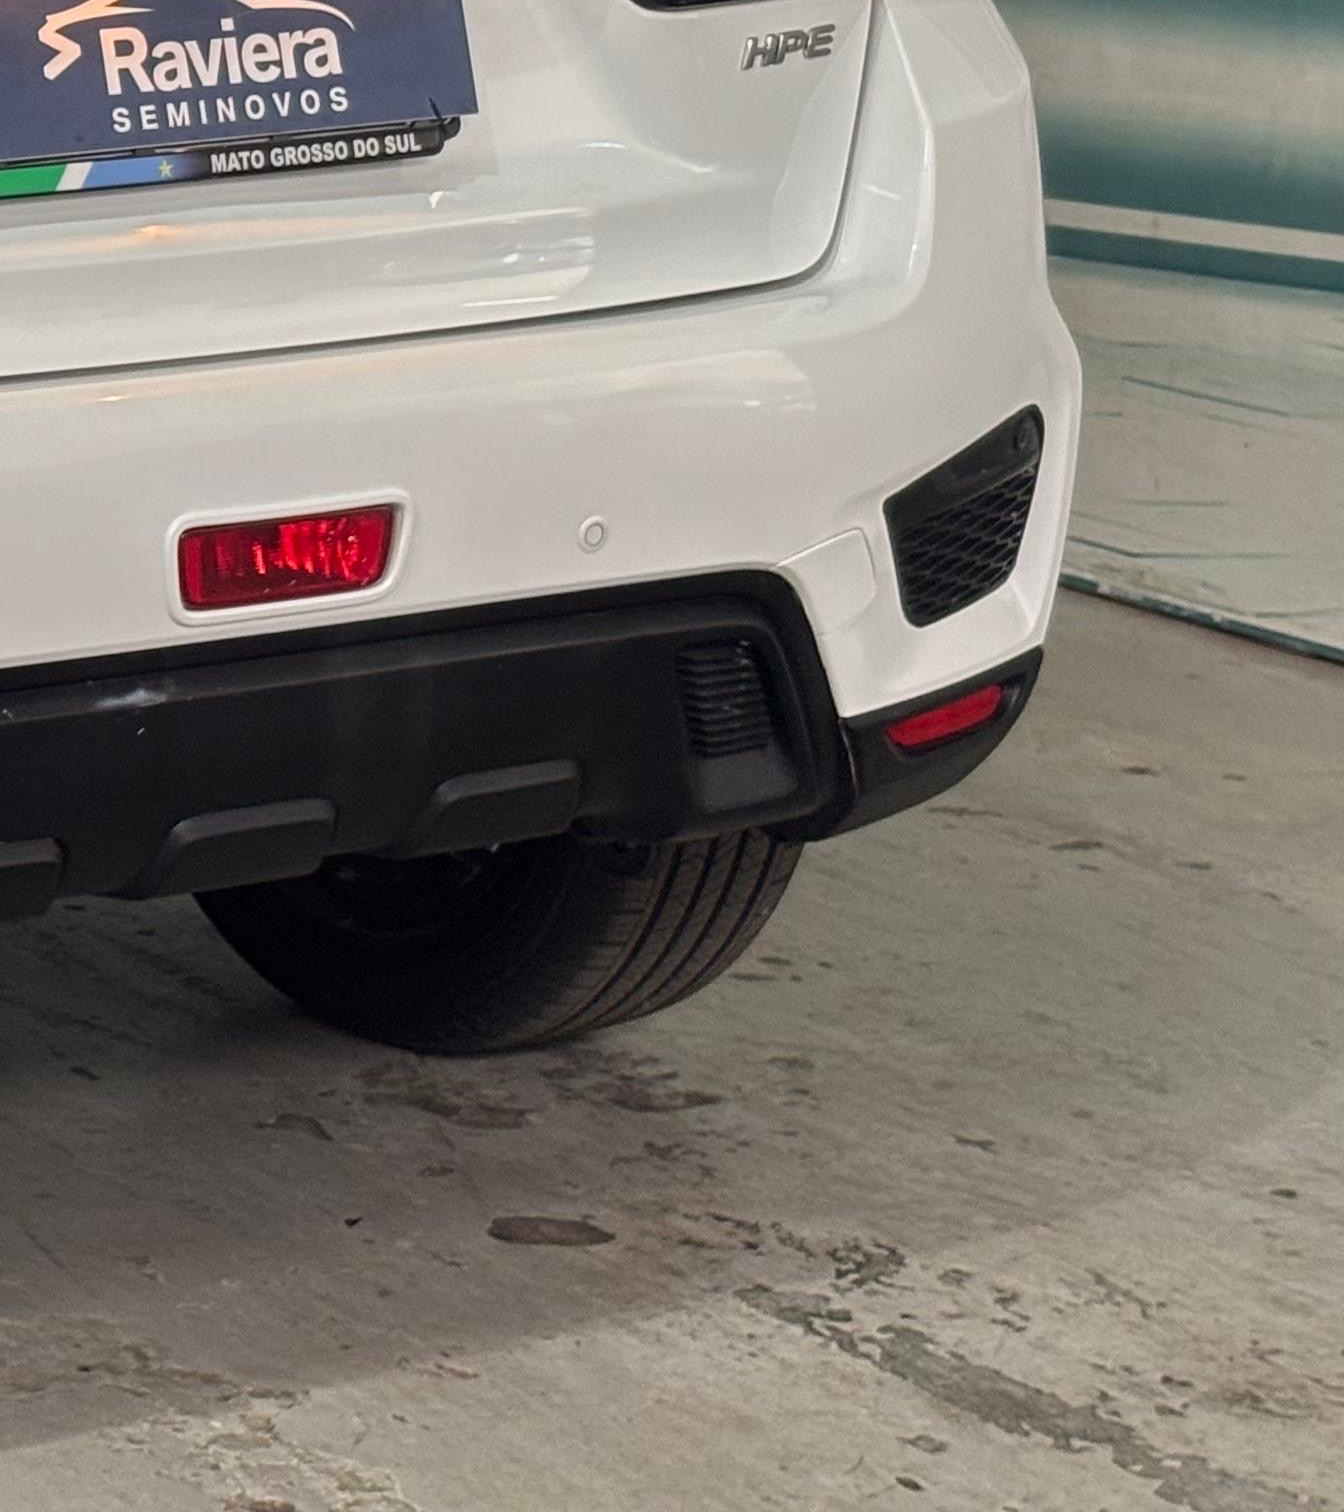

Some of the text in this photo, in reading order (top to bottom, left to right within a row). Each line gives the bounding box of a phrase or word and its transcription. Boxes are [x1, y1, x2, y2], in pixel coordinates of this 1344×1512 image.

[99, 17, 344, 95] Raviera
[741, 23, 836, 70] HPE
[112, 86, 349, 133] SEMINOVOS
[210, 131, 422, 175] MATO GROSSO DO SUL
